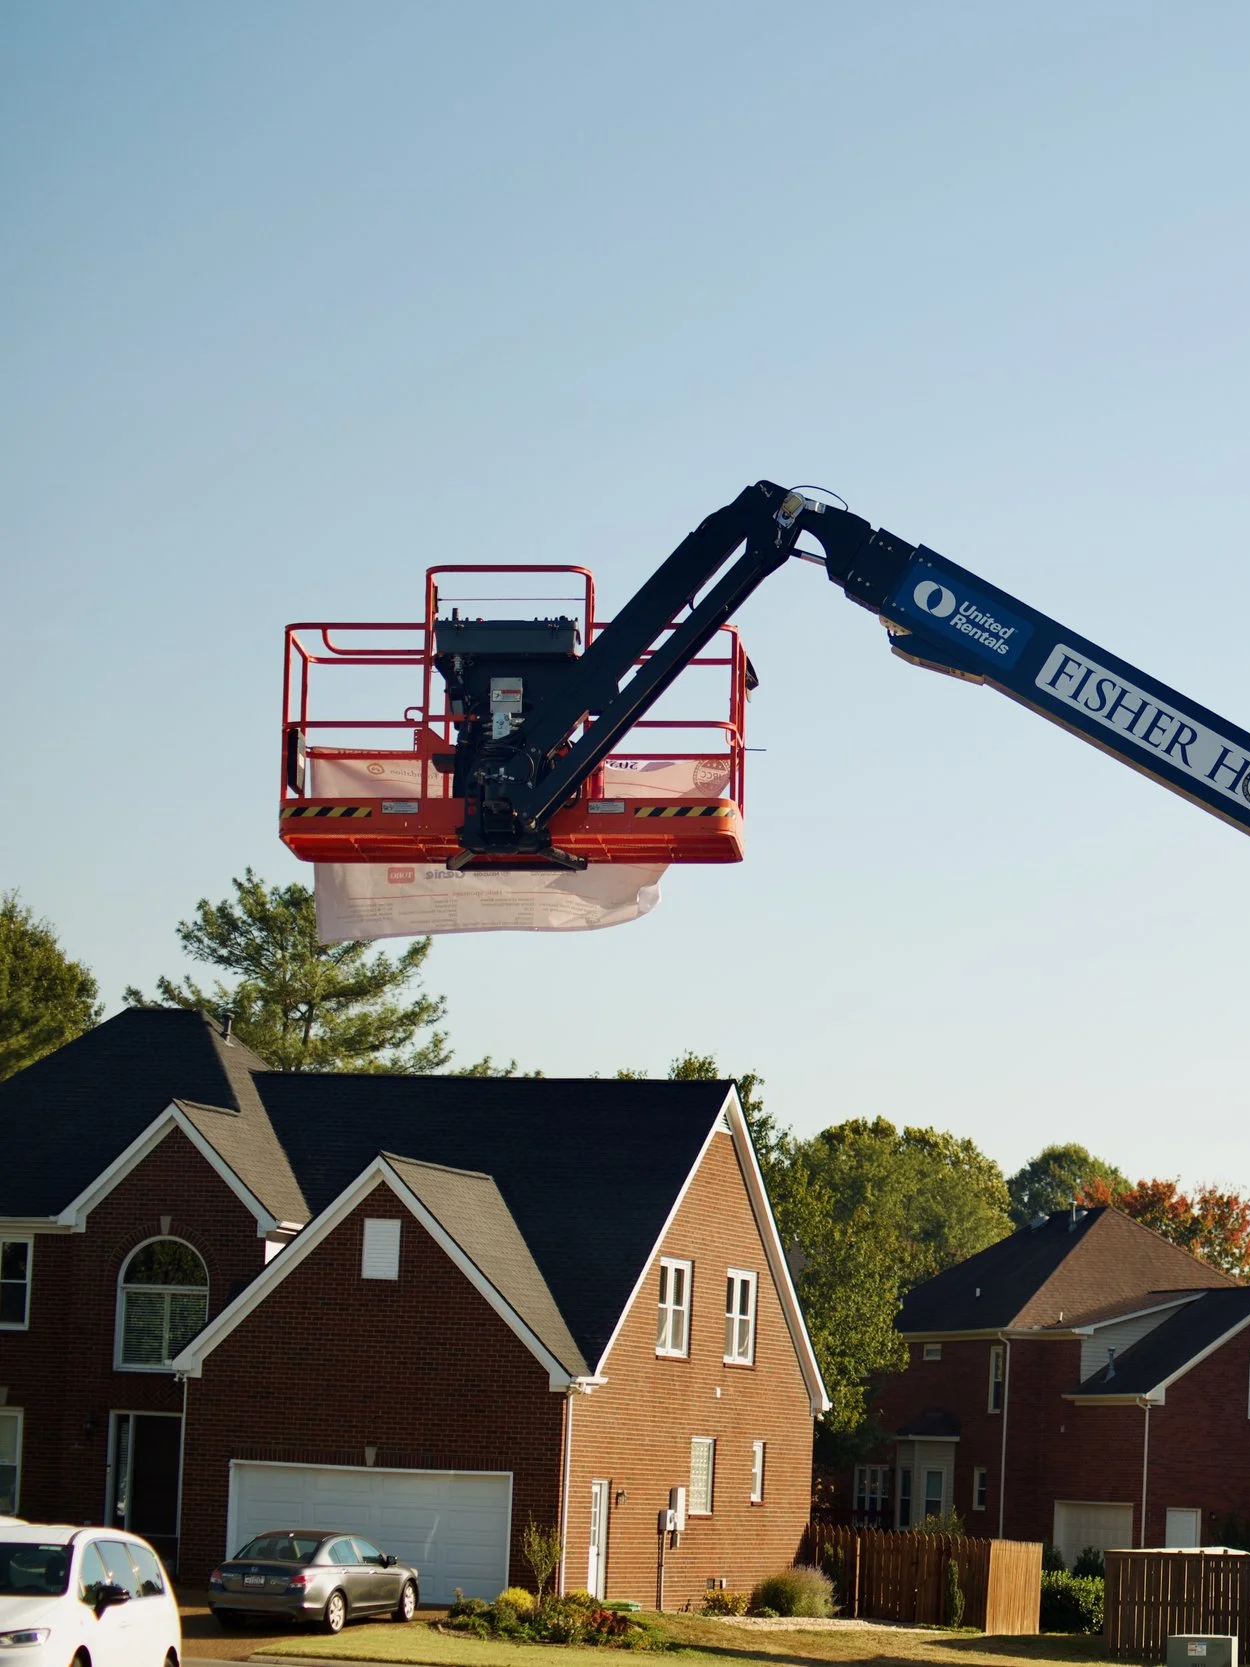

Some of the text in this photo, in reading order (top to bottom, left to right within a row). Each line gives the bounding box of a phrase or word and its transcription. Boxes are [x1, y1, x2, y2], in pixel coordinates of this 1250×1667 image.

[949, 613, 1009, 655] Rentals
[958, 601, 1015, 639] United
[1046, 653, 1198, 768] FISHER
